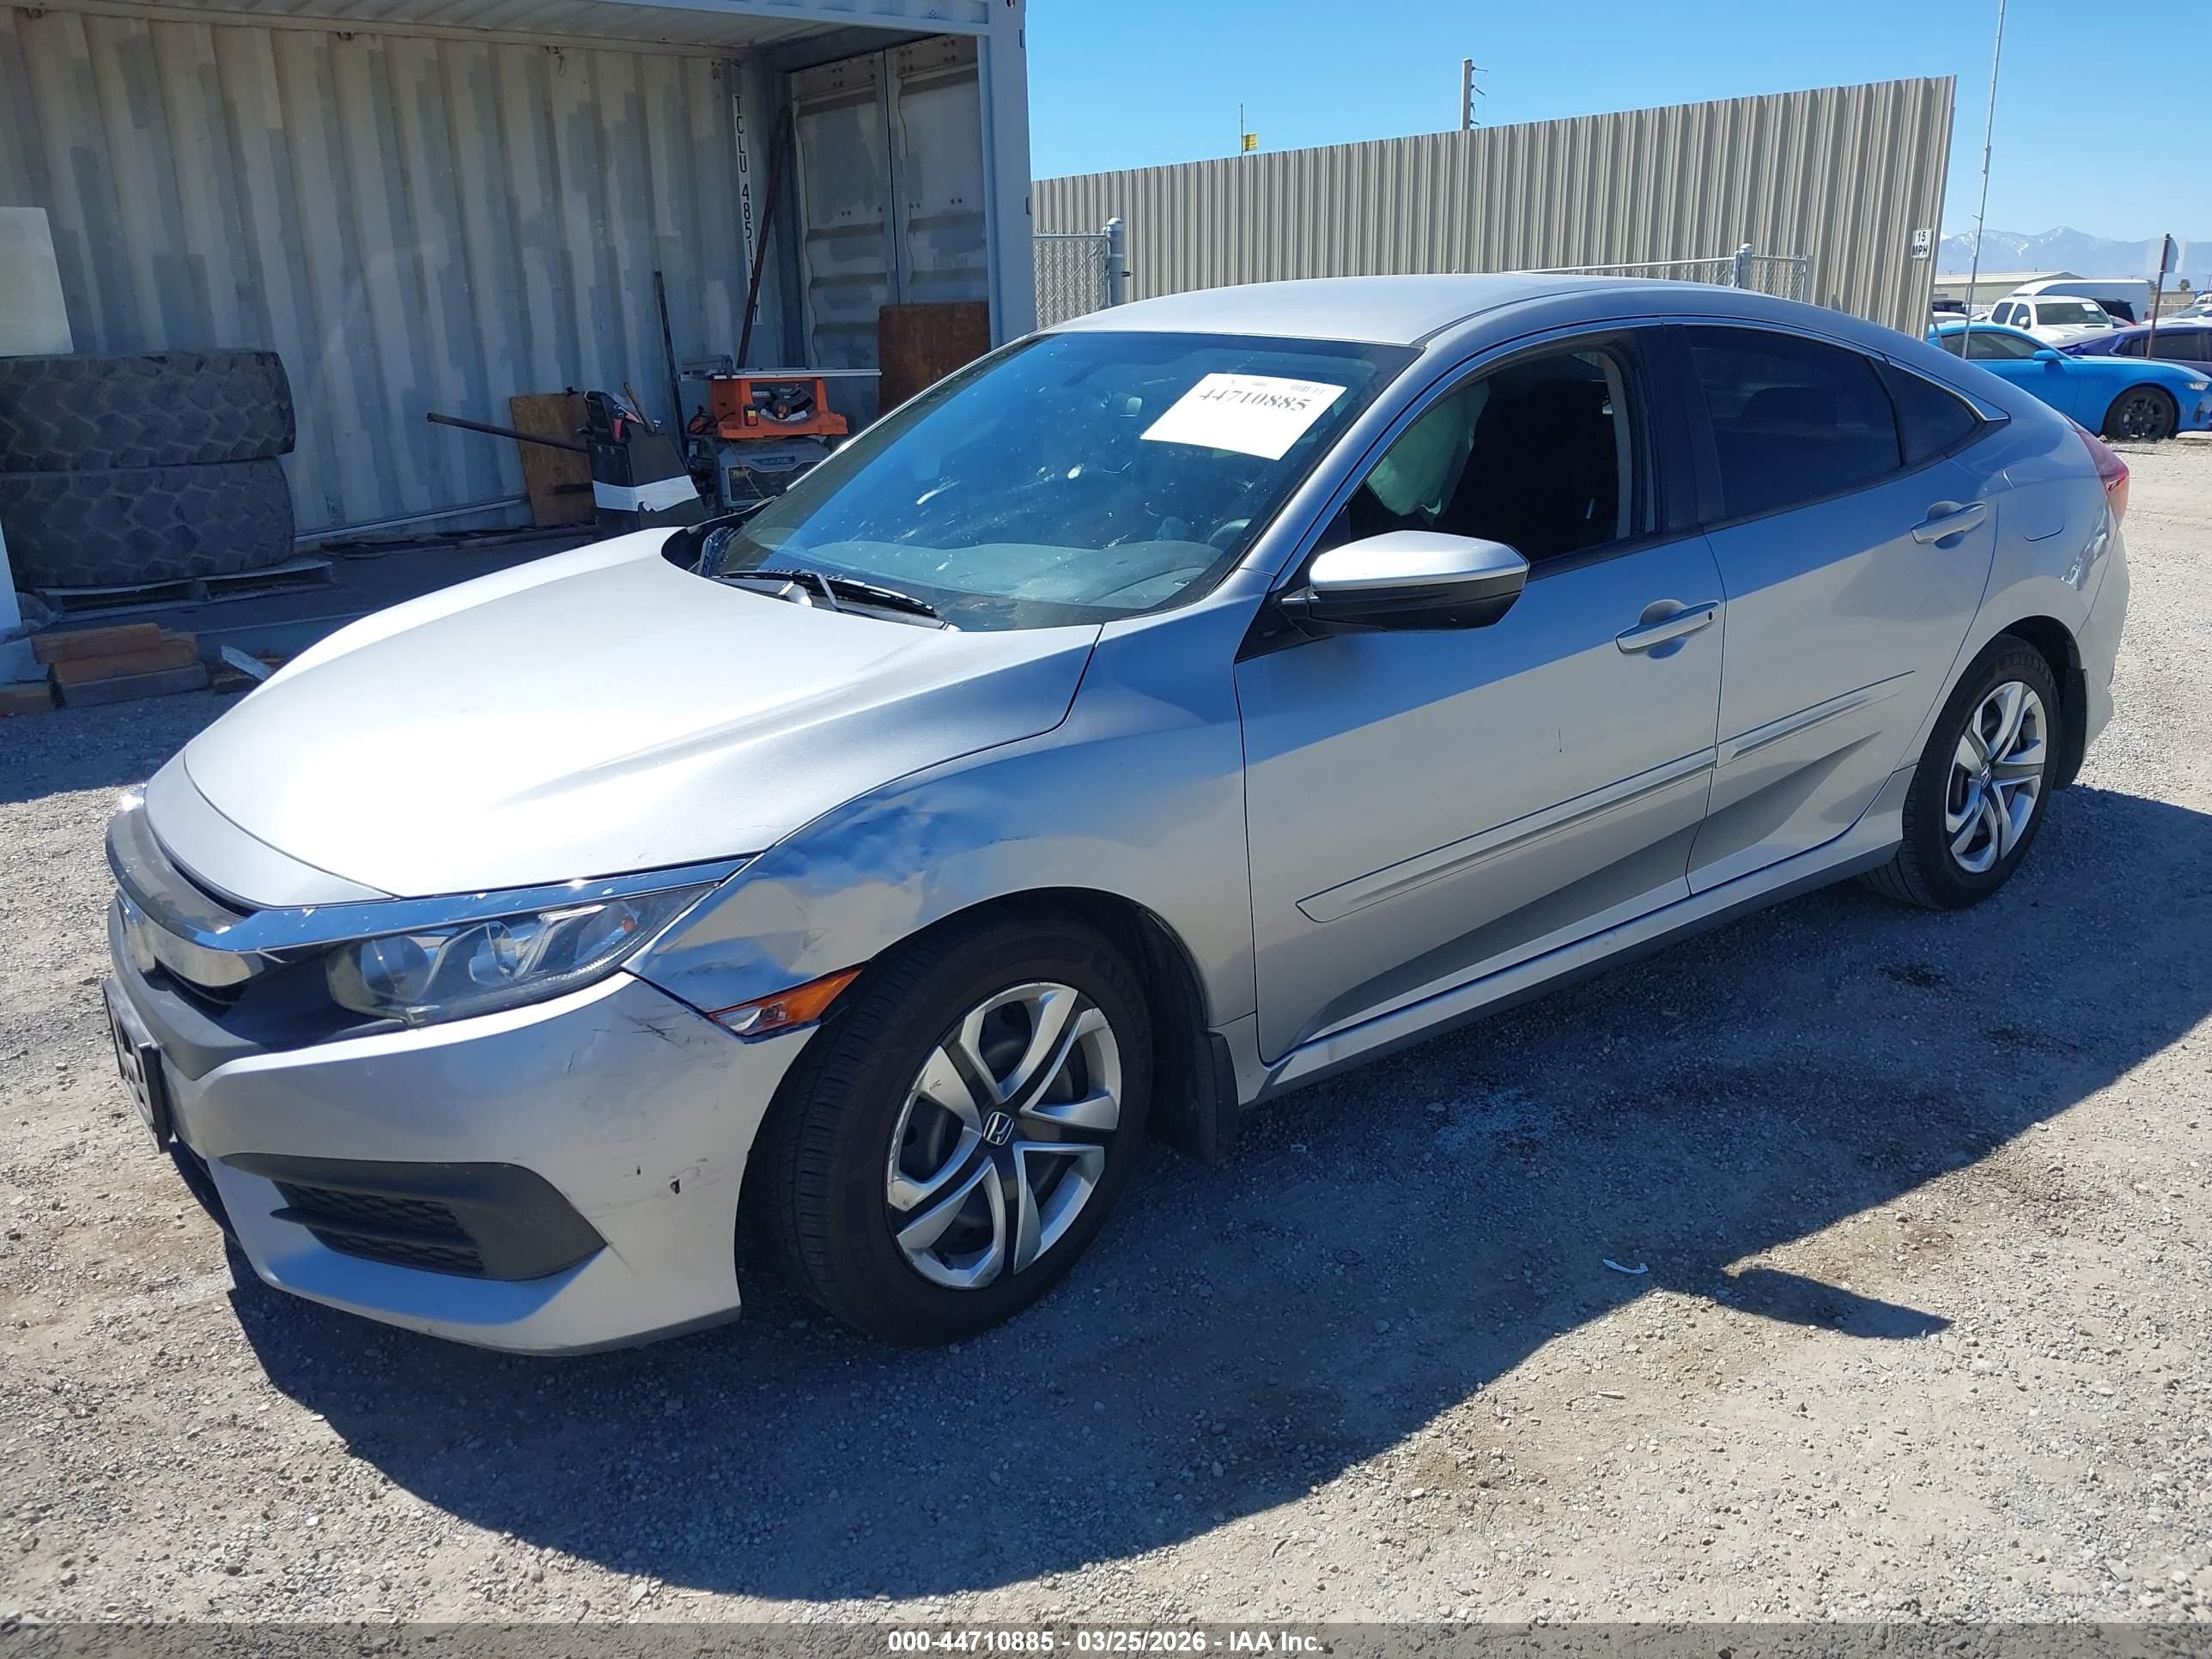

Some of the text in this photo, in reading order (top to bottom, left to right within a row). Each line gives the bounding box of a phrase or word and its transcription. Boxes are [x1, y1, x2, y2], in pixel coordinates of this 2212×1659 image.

[734, 95, 747, 173] TCLU
[1917, 231, 1926, 242] 15
[1911, 245, 1929, 256] MPH
[1199, 389, 1312, 411] 44710885
